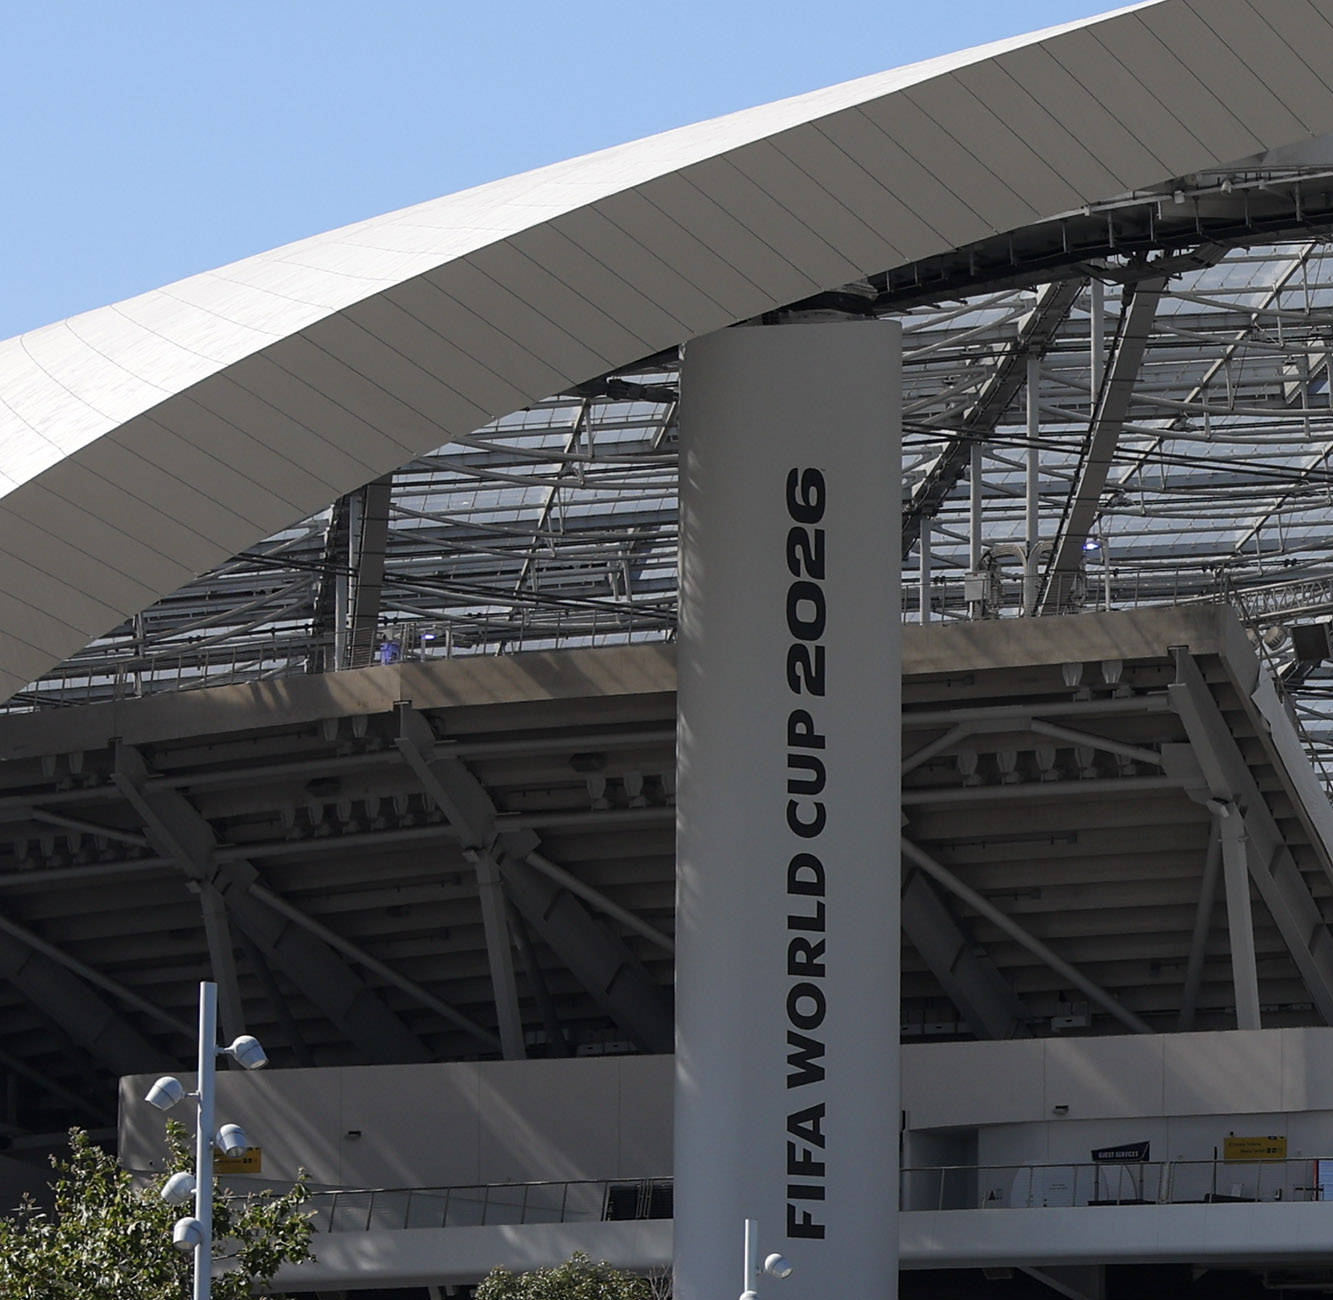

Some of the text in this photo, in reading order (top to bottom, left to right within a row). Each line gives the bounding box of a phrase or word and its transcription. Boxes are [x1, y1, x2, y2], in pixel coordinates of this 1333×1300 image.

[785, 467, 826, 1240] FIFA WORLD CUP 2026
